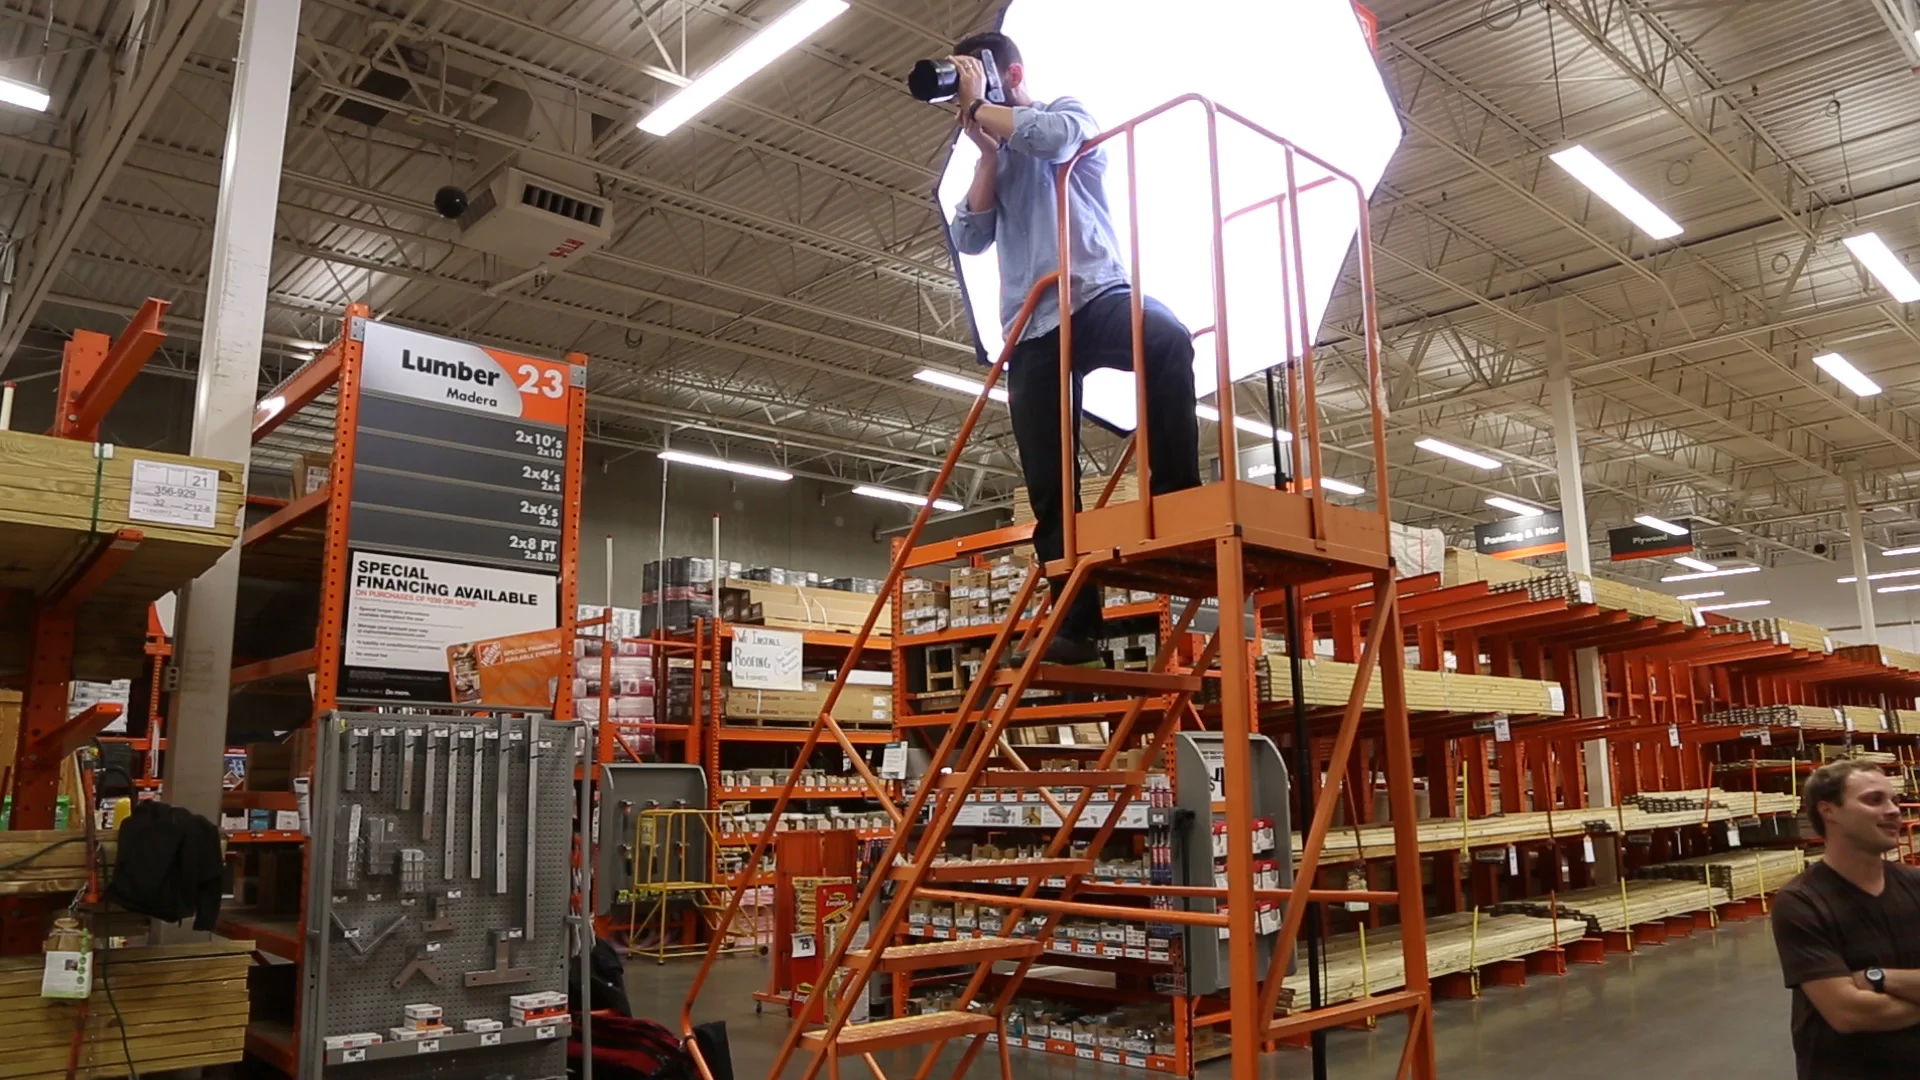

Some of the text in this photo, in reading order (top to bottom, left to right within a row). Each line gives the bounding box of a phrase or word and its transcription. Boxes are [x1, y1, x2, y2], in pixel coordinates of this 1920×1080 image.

[401, 349, 565, 399] Lumber 23
[446, 387, 498, 407] Madera
[515, 430, 563, 449] 2x10's
[536, 446, 563, 459] 2x10
[192, 475, 208, 488] 21
[522, 466, 561, 483] 2x4's
[155, 485, 197, 499] 356-929
[541, 481, 560, 492] 2x4
[519, 501, 560, 518] 2x6's
[538, 516, 560, 527] 2x6
[509, 535, 558, 553] 2x8 PT
[1483, 532, 1524, 546] Paneling
[1525, 528, 1534, 539] &
[1632, 533, 1669, 546] Plywood
[524, 550, 558, 562] 2x8 TP
[357, 560, 430, 580] SPECIAL
[356, 575, 538, 606] FINANCING AVAILABLE
